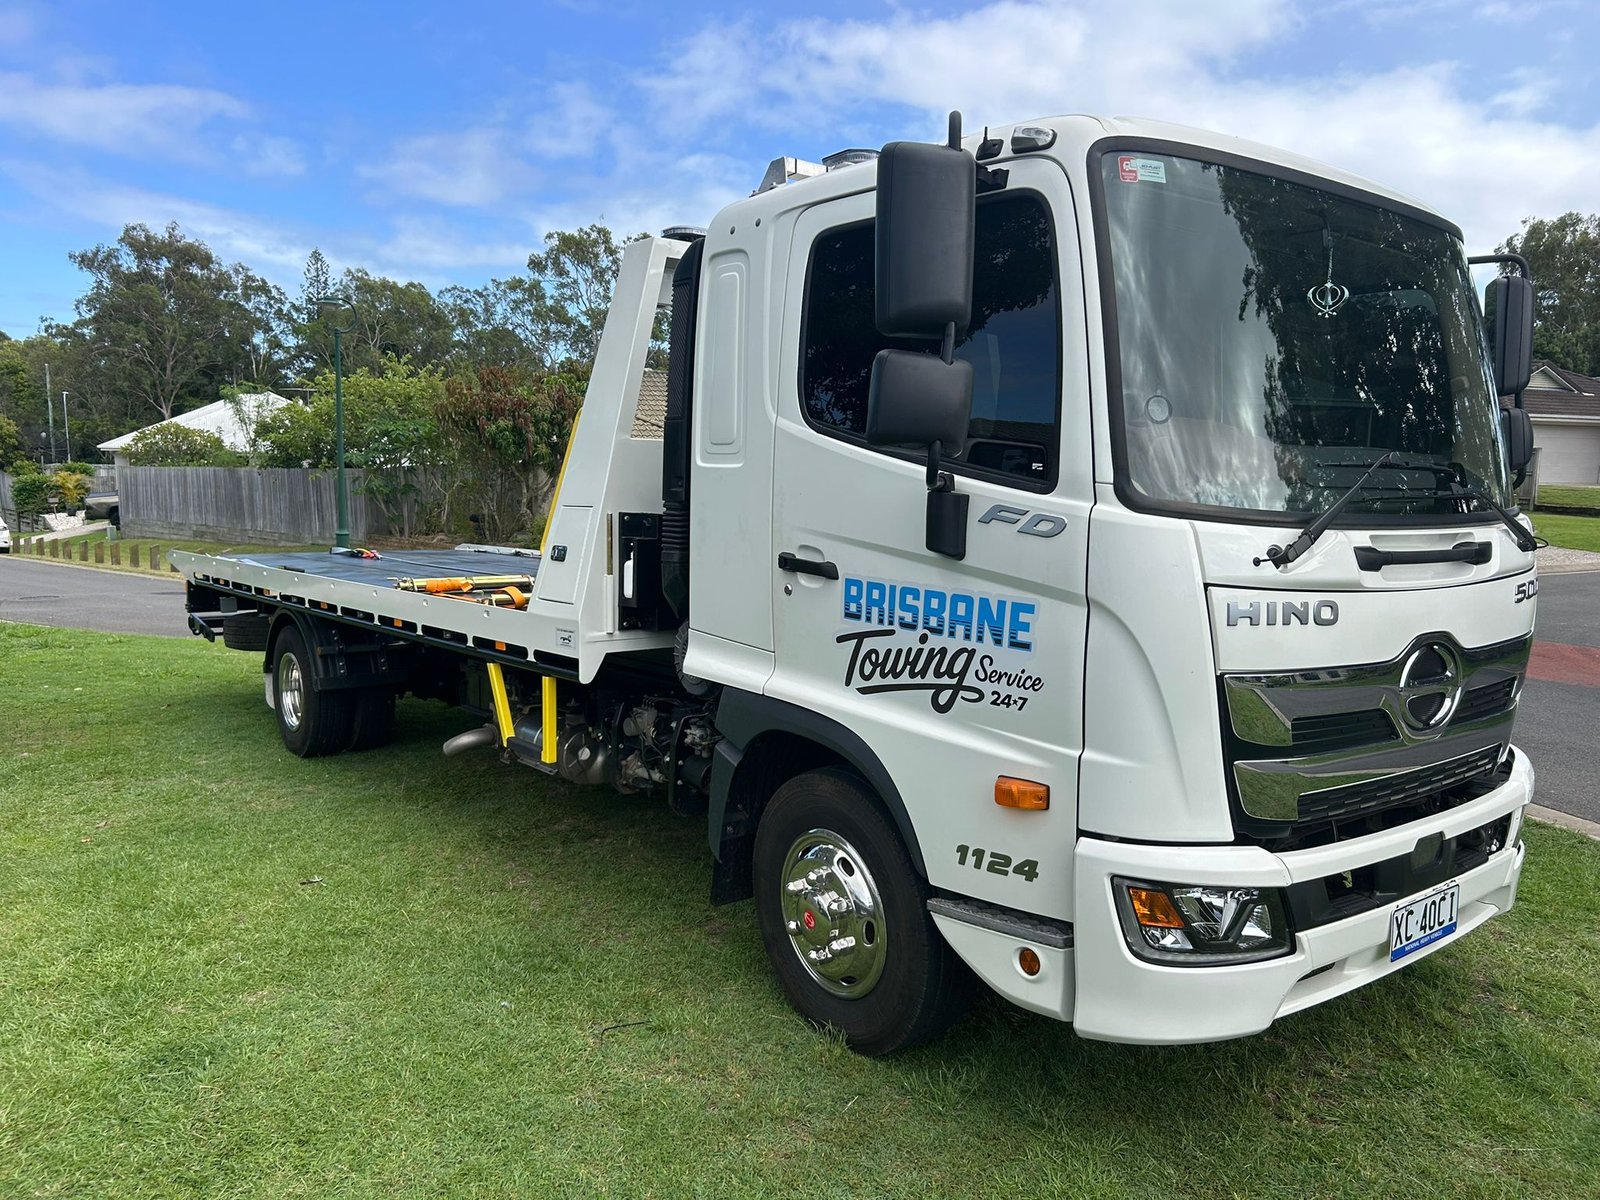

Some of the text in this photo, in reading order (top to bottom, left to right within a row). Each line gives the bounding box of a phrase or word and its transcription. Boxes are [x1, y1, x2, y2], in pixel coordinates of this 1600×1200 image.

[978, 504, 1067, 538] FD
[844, 577, 1036, 652] BRISBANE
[1226, 600, 1339, 627] HINO
[836, 629, 1044, 714] Towing Service
[956, 844, 1039, 882] 1124
